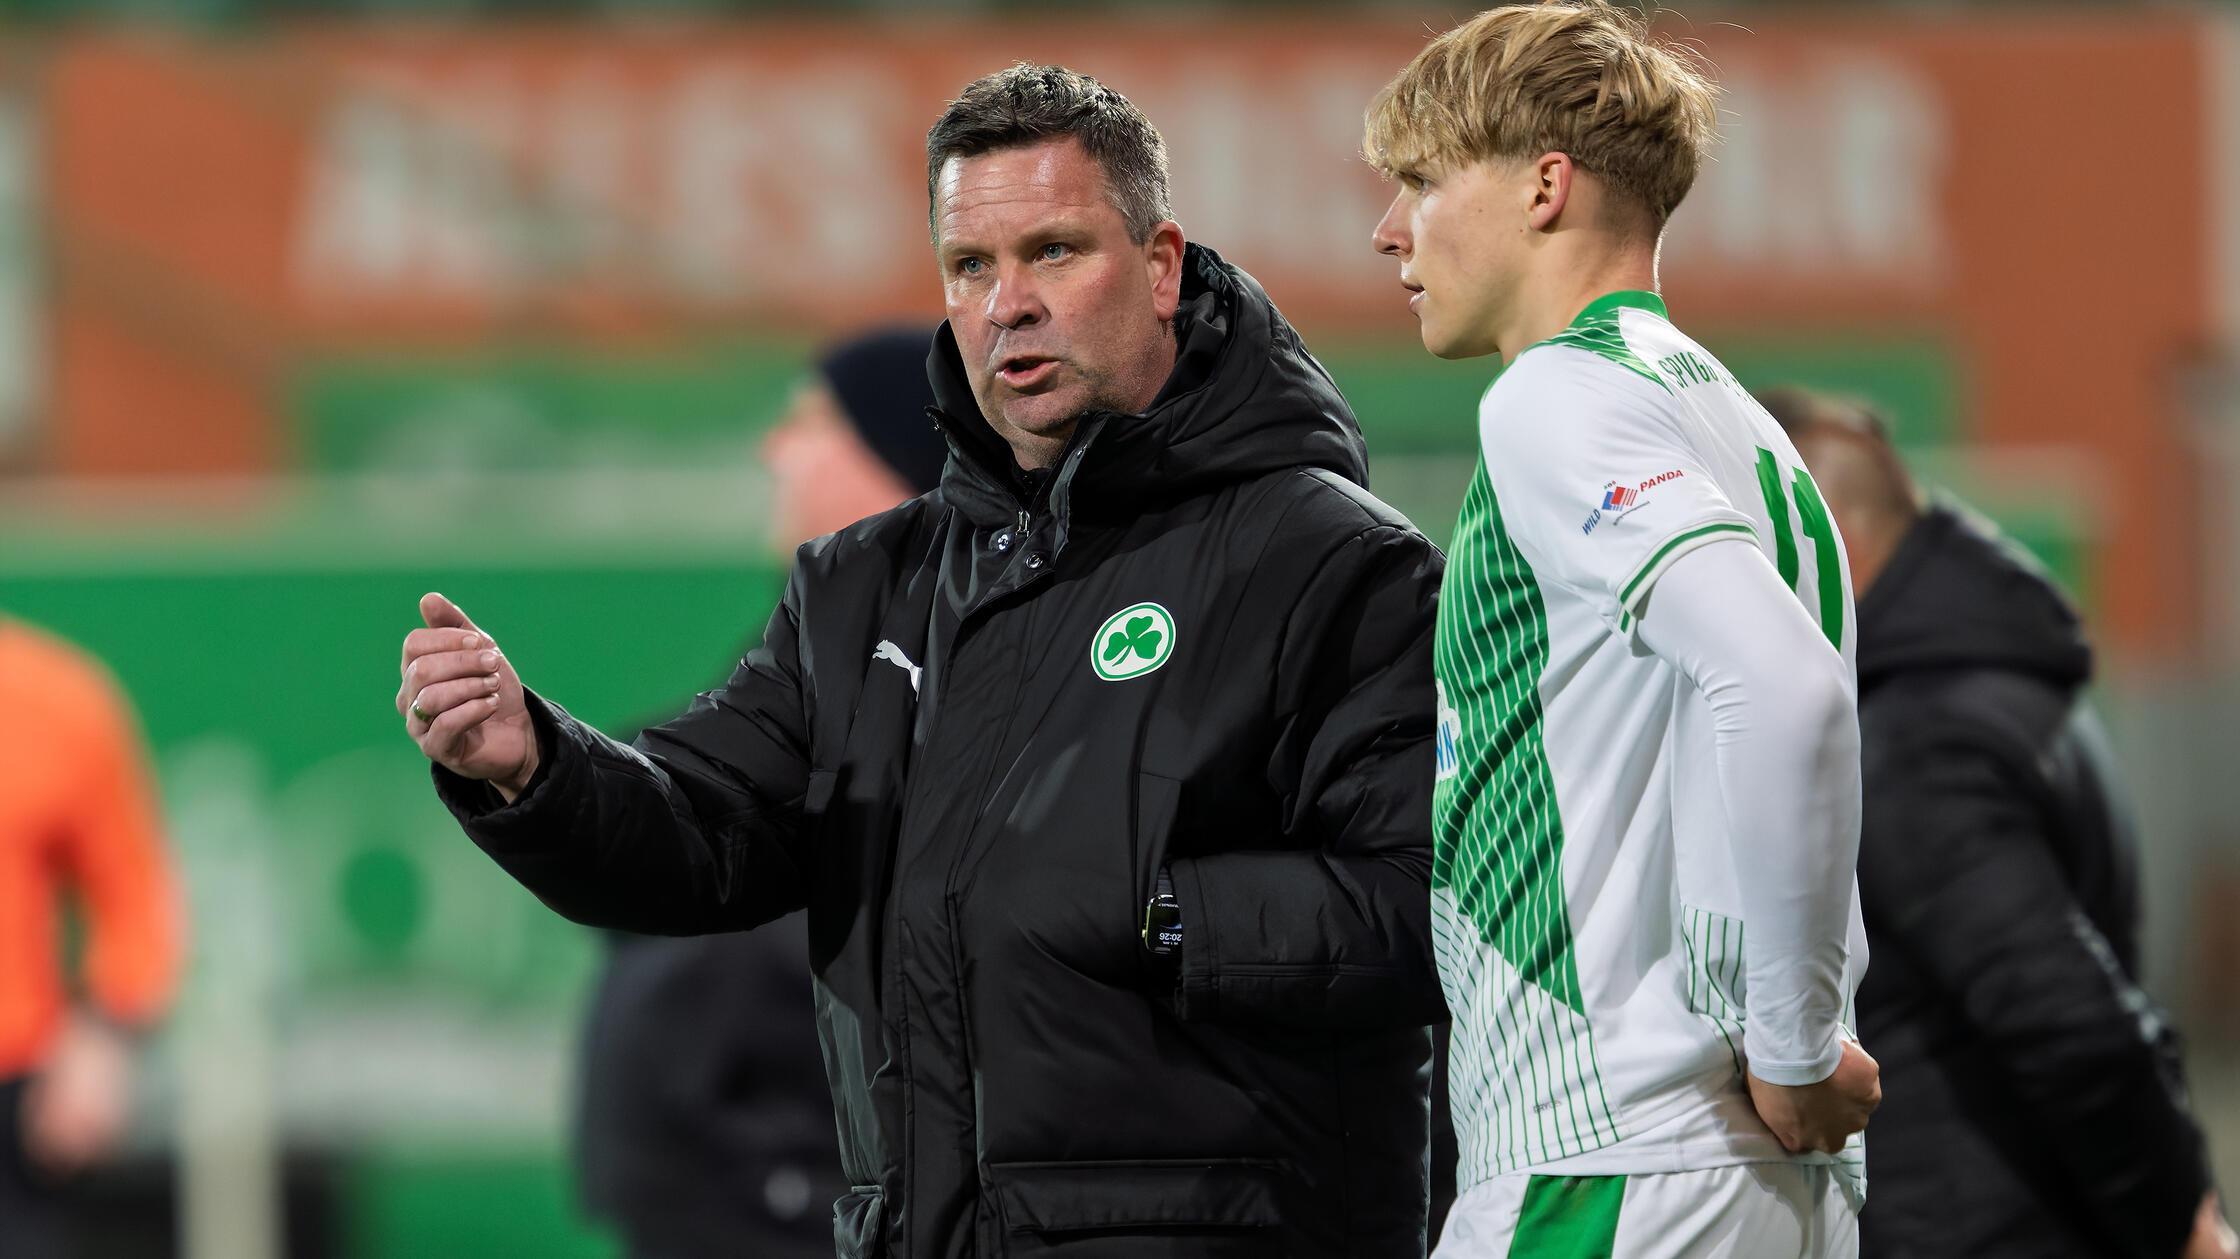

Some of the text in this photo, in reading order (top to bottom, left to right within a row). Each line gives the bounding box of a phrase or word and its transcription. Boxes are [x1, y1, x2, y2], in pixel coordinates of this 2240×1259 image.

[1581, 508, 1602, 536] WILD
[1639, 469, 1685, 493] PANDA
[1755, 445, 1844, 655] 11
[1159, 932, 1183, 942] 20:26
